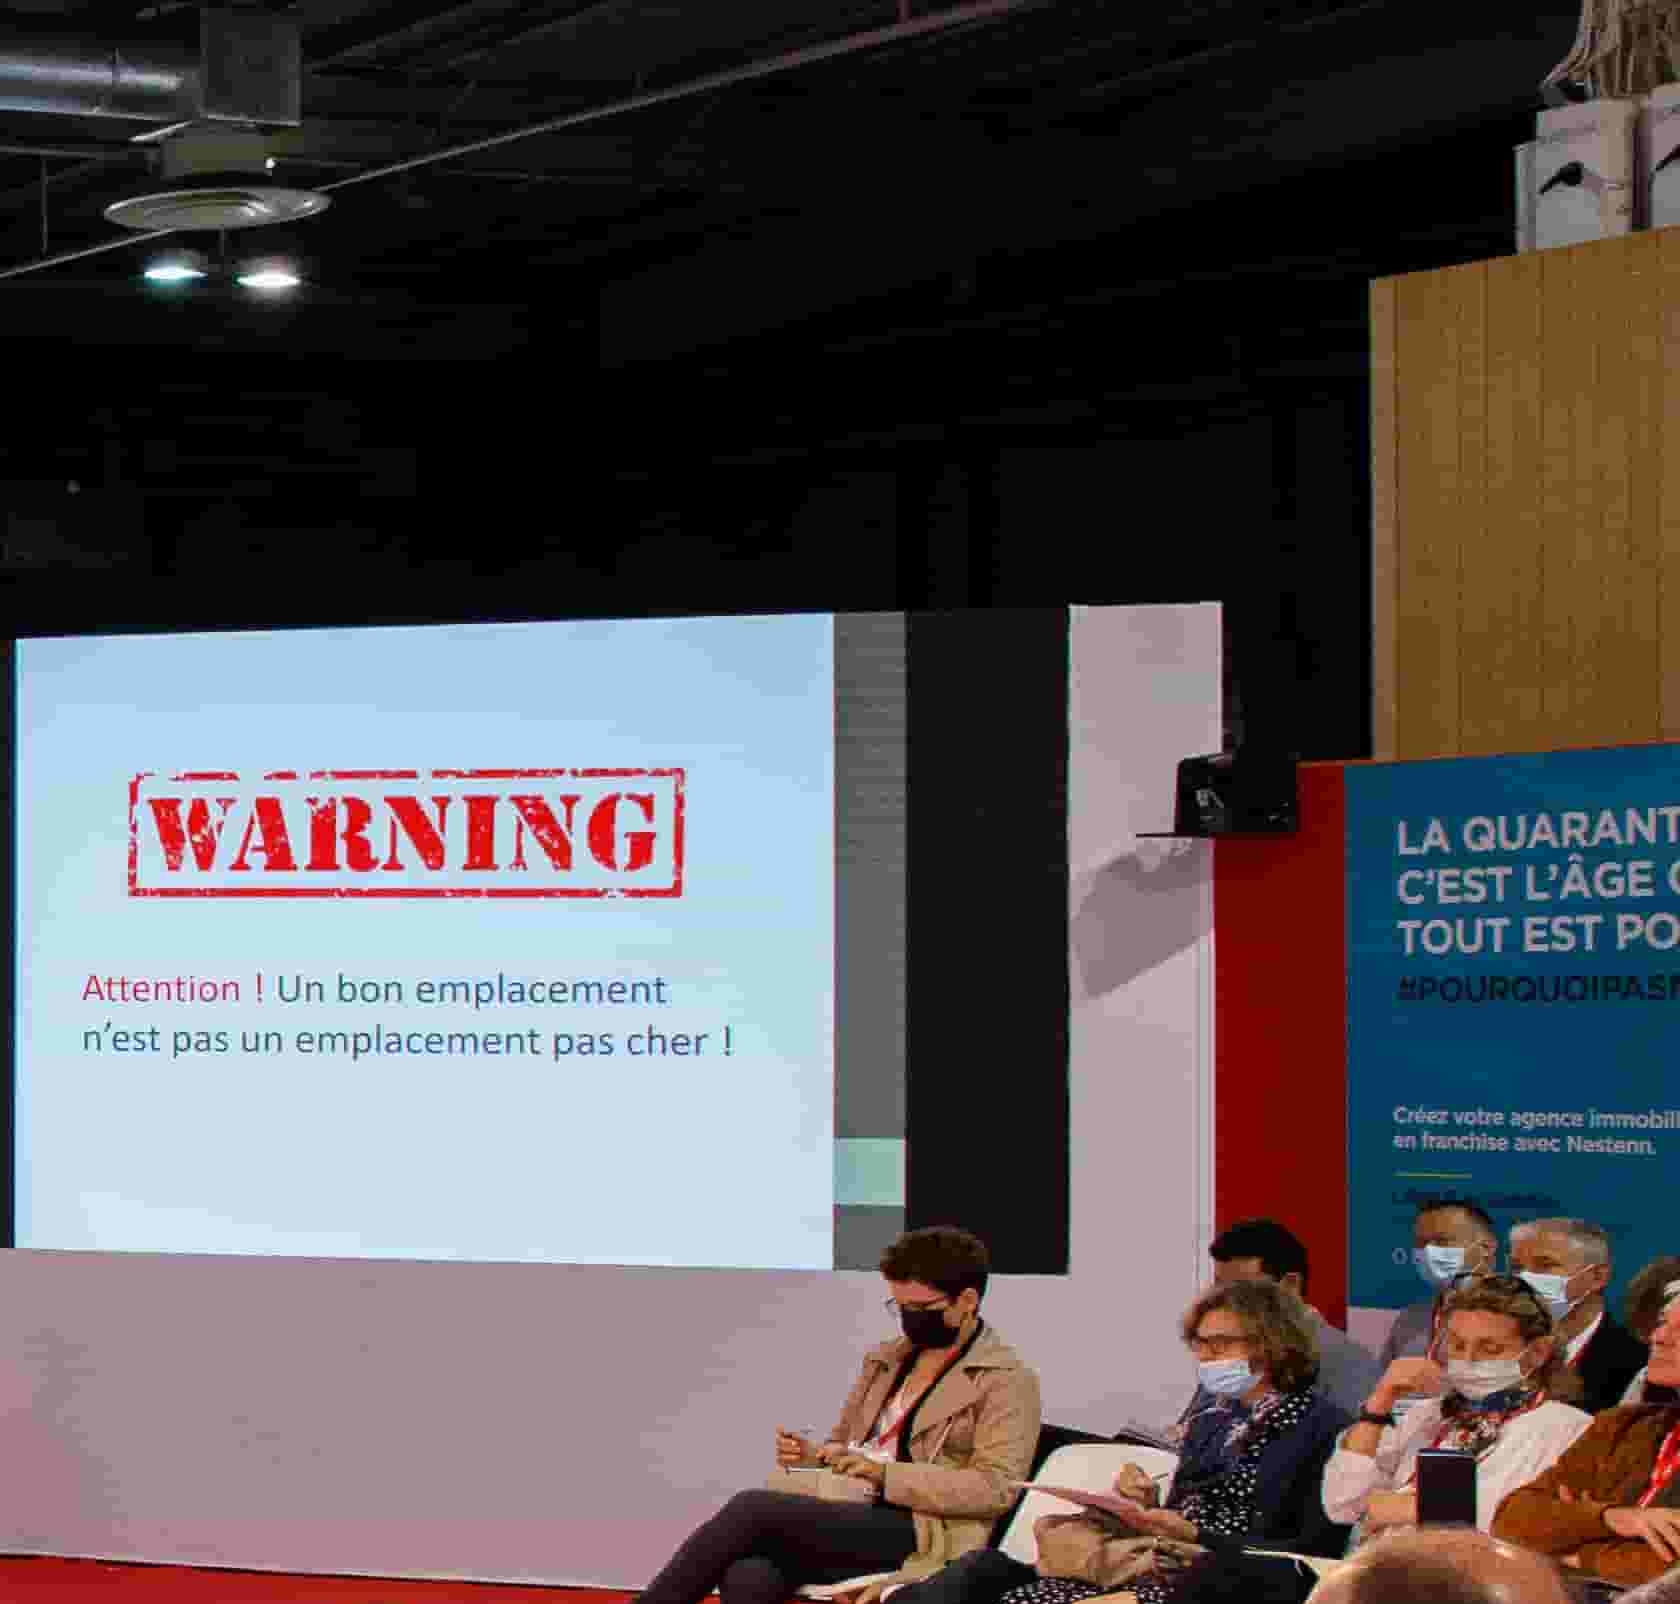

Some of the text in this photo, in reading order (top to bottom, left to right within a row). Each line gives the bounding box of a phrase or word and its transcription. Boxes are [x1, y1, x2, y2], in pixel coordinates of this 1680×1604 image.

[147, 791, 660, 875] WARNING
[1398, 806, 1680, 855] LA QUARANT
[1397, 916, 1510, 956] TOUT
[1522, 914, 1602, 952] EST
[82, 974, 241, 1003] Attention
[277, 974, 325, 1004] Un
[336, 971, 404, 1004] bon
[415, 971, 667, 1011] emplacement
[82, 1021, 161, 1052] n'est
[172, 1030, 230, 1059] pas
[240, 1031, 283, 1053] un
[295, 1023, 542, 1061] emplacement
[553, 1032, 614, 1062] pas
[626, 1023, 710, 1056] cher
[1453, 1107, 1505, 1126] votre
[1511, 1110, 1584, 1130] agence
[1393, 1134, 1417, 1150] en
[1424, 1131, 1508, 1152] franchise
[1513, 1135, 1561, 1151] avec
